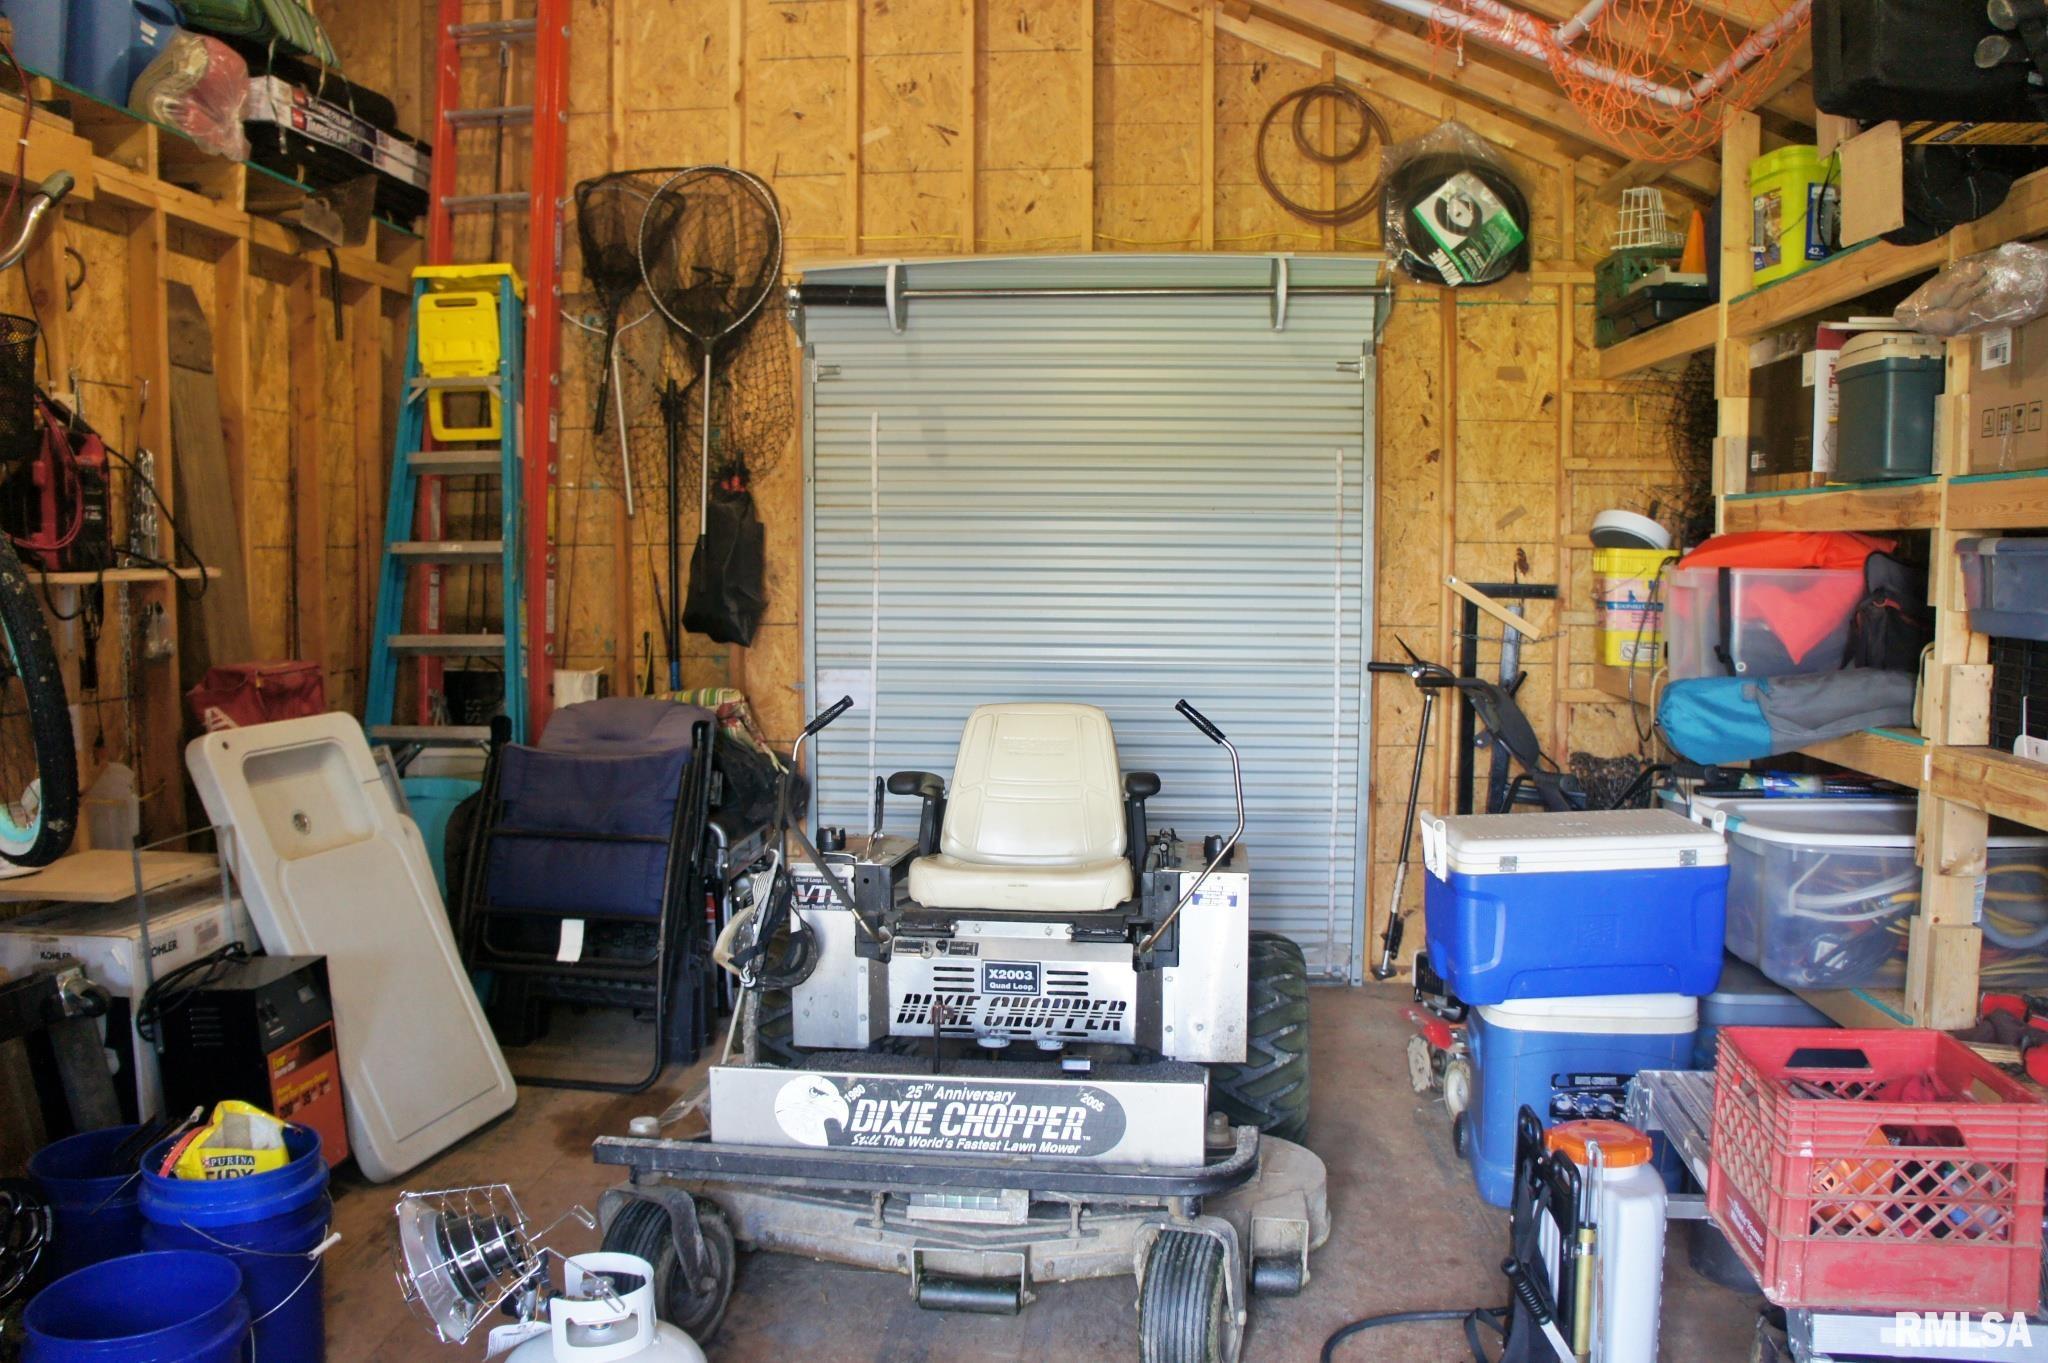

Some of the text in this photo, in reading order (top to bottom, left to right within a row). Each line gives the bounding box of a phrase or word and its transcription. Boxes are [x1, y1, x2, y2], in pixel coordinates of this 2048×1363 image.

[1428, 248, 1463, 287] WAYNE
[40, 952, 72, 960] KOHLER
[151, 939, 178, 957] OHLER
[988, 969, 1034, 980] X2003
[897, 993, 1127, 1031] DIXIE CHOPPER
[933, 1086, 1016, 1106] Anniversary
[1080, 1093, 1105, 1112] 2005
[850, 1099, 938, 1135] DIXIE
[939, 1101, 1087, 1141] CHOPPER
[851, 1133, 1082, 1154] Still The World's Fastest Lawn Mower
[210, 1155, 255, 1166] PURINA
